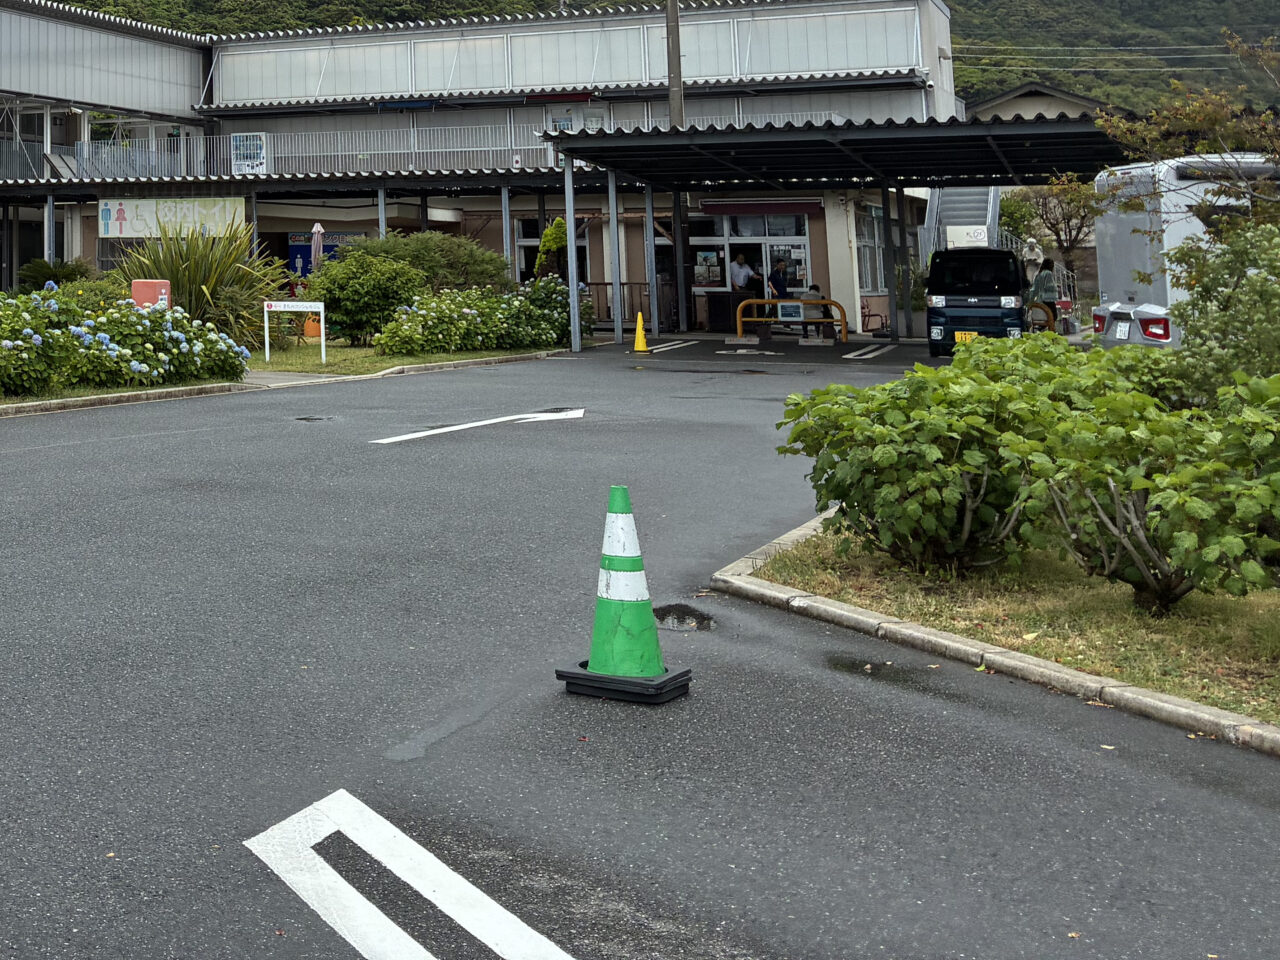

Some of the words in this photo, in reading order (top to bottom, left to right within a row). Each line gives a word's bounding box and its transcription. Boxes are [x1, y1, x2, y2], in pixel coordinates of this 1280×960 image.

[158, 200, 243, 223] 校内トイレ
